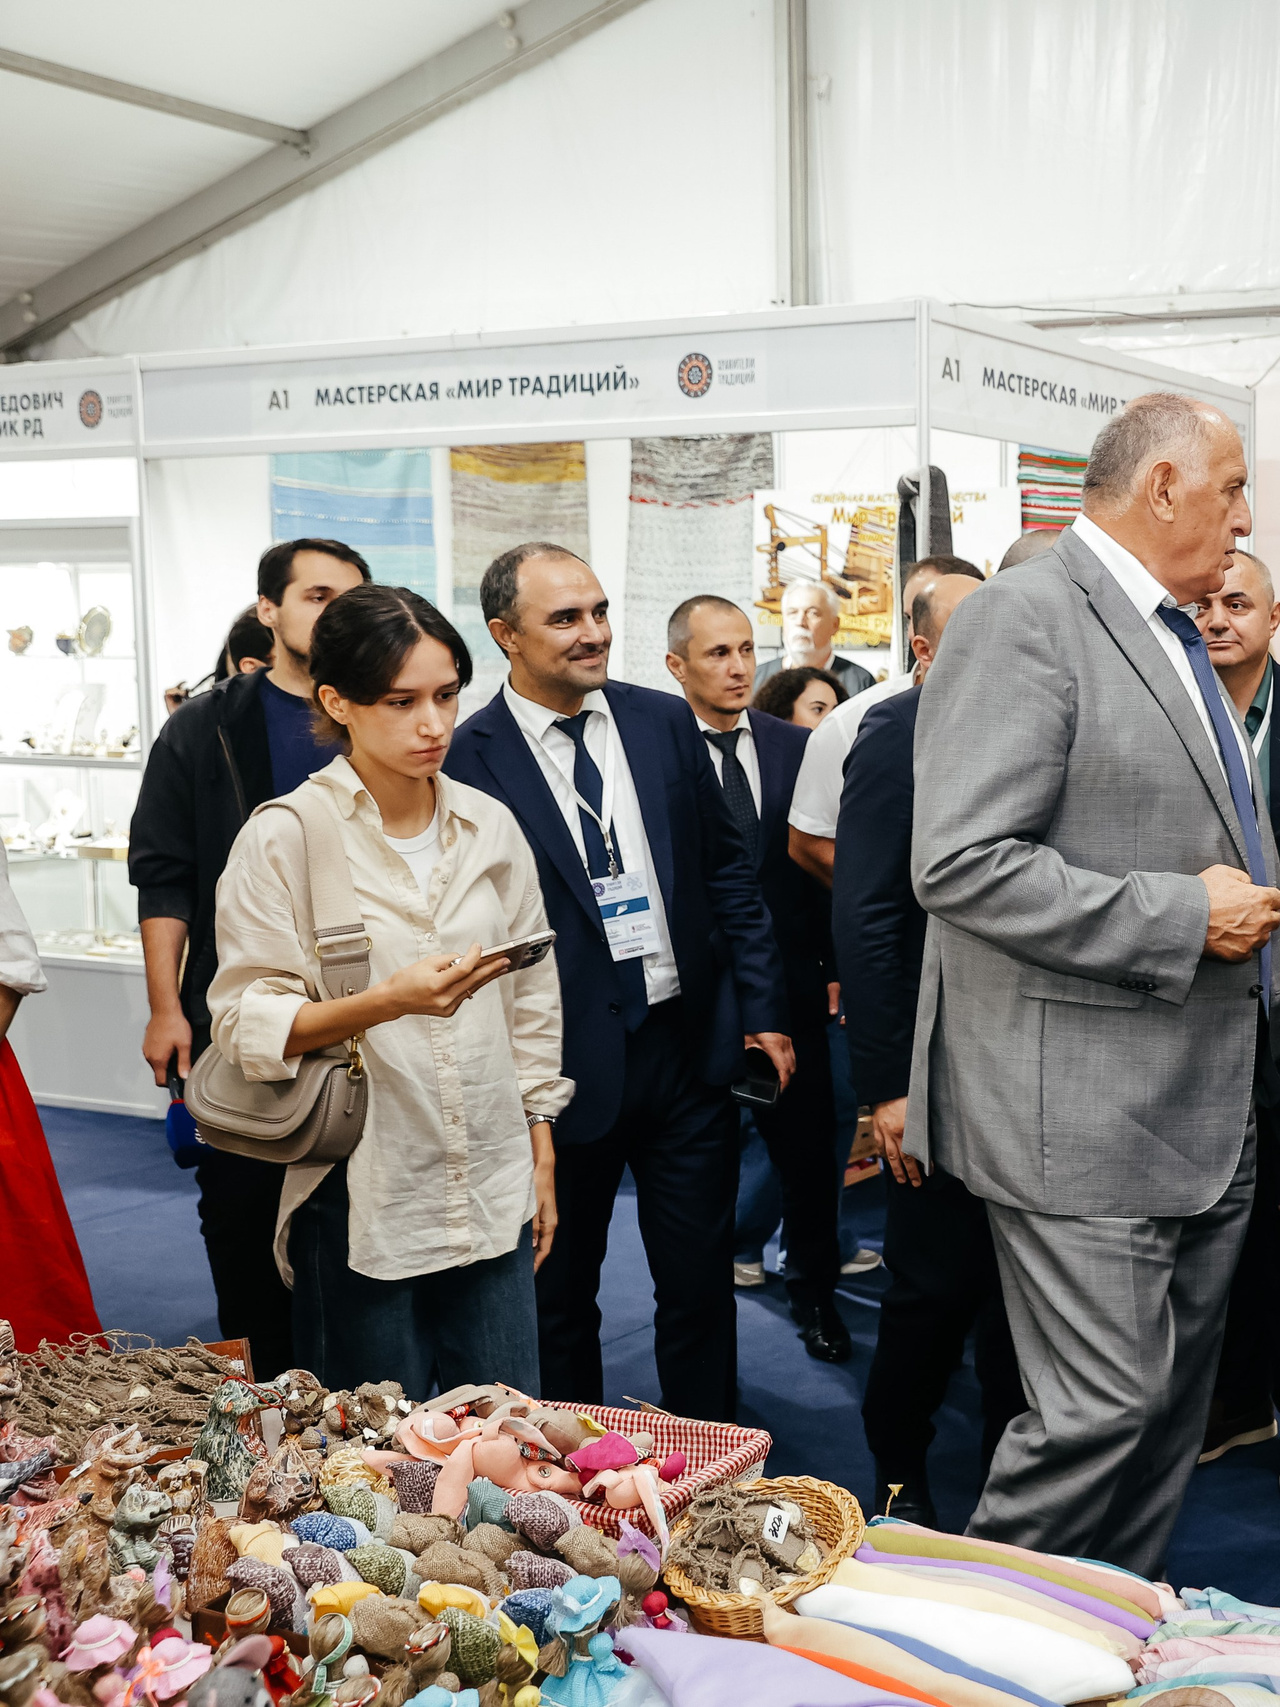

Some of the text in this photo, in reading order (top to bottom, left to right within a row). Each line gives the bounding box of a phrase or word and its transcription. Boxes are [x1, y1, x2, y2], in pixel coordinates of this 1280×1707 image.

[315, 364, 640, 406] МАСТЕРСКАЯ «МИР ТРАДИЦИЙ»
[982, 366, 1117, 414] МАСТЕРСКАЯ «МИР
[23, 418, 44, 438] РД
